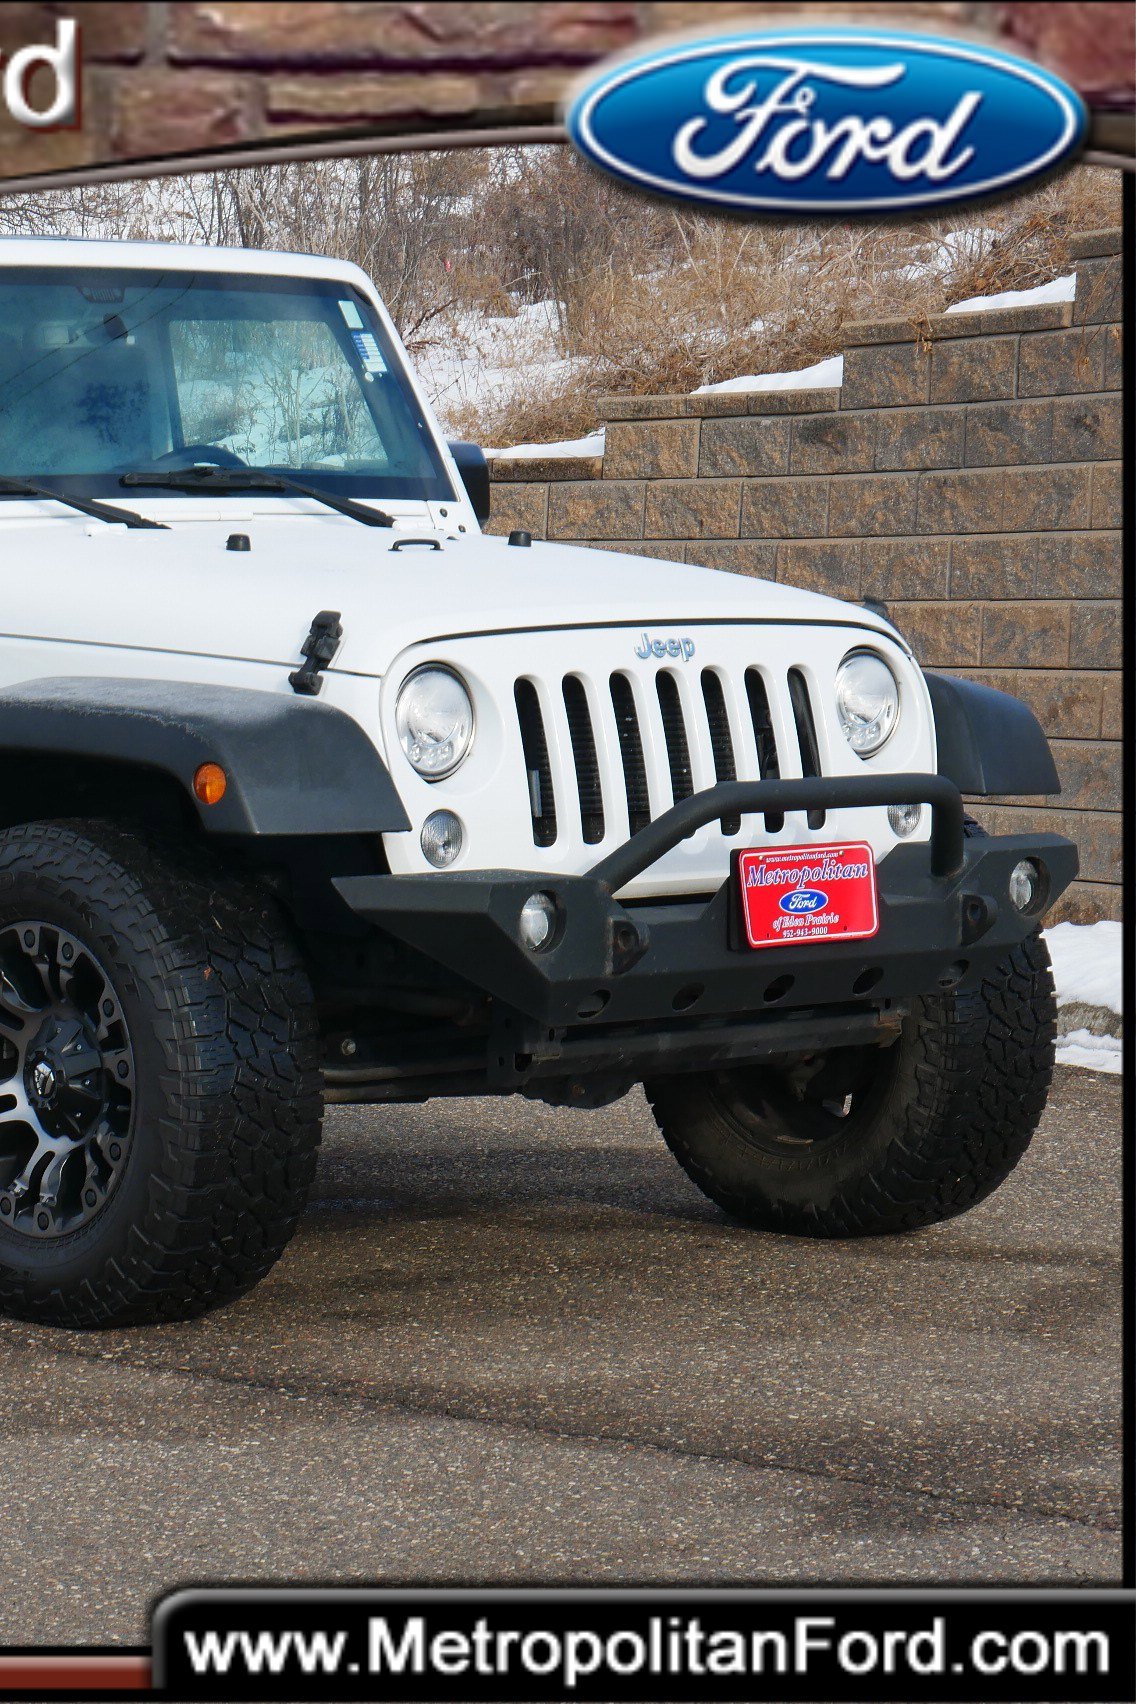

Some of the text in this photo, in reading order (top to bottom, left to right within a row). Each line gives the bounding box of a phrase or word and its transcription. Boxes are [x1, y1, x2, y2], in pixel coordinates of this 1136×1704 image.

[635, 632, 696, 662] Jeep
[747, 858, 869, 889] Metropolitan
[789, 893, 817, 909] Ford
[805, 912, 840, 926] Prairie
